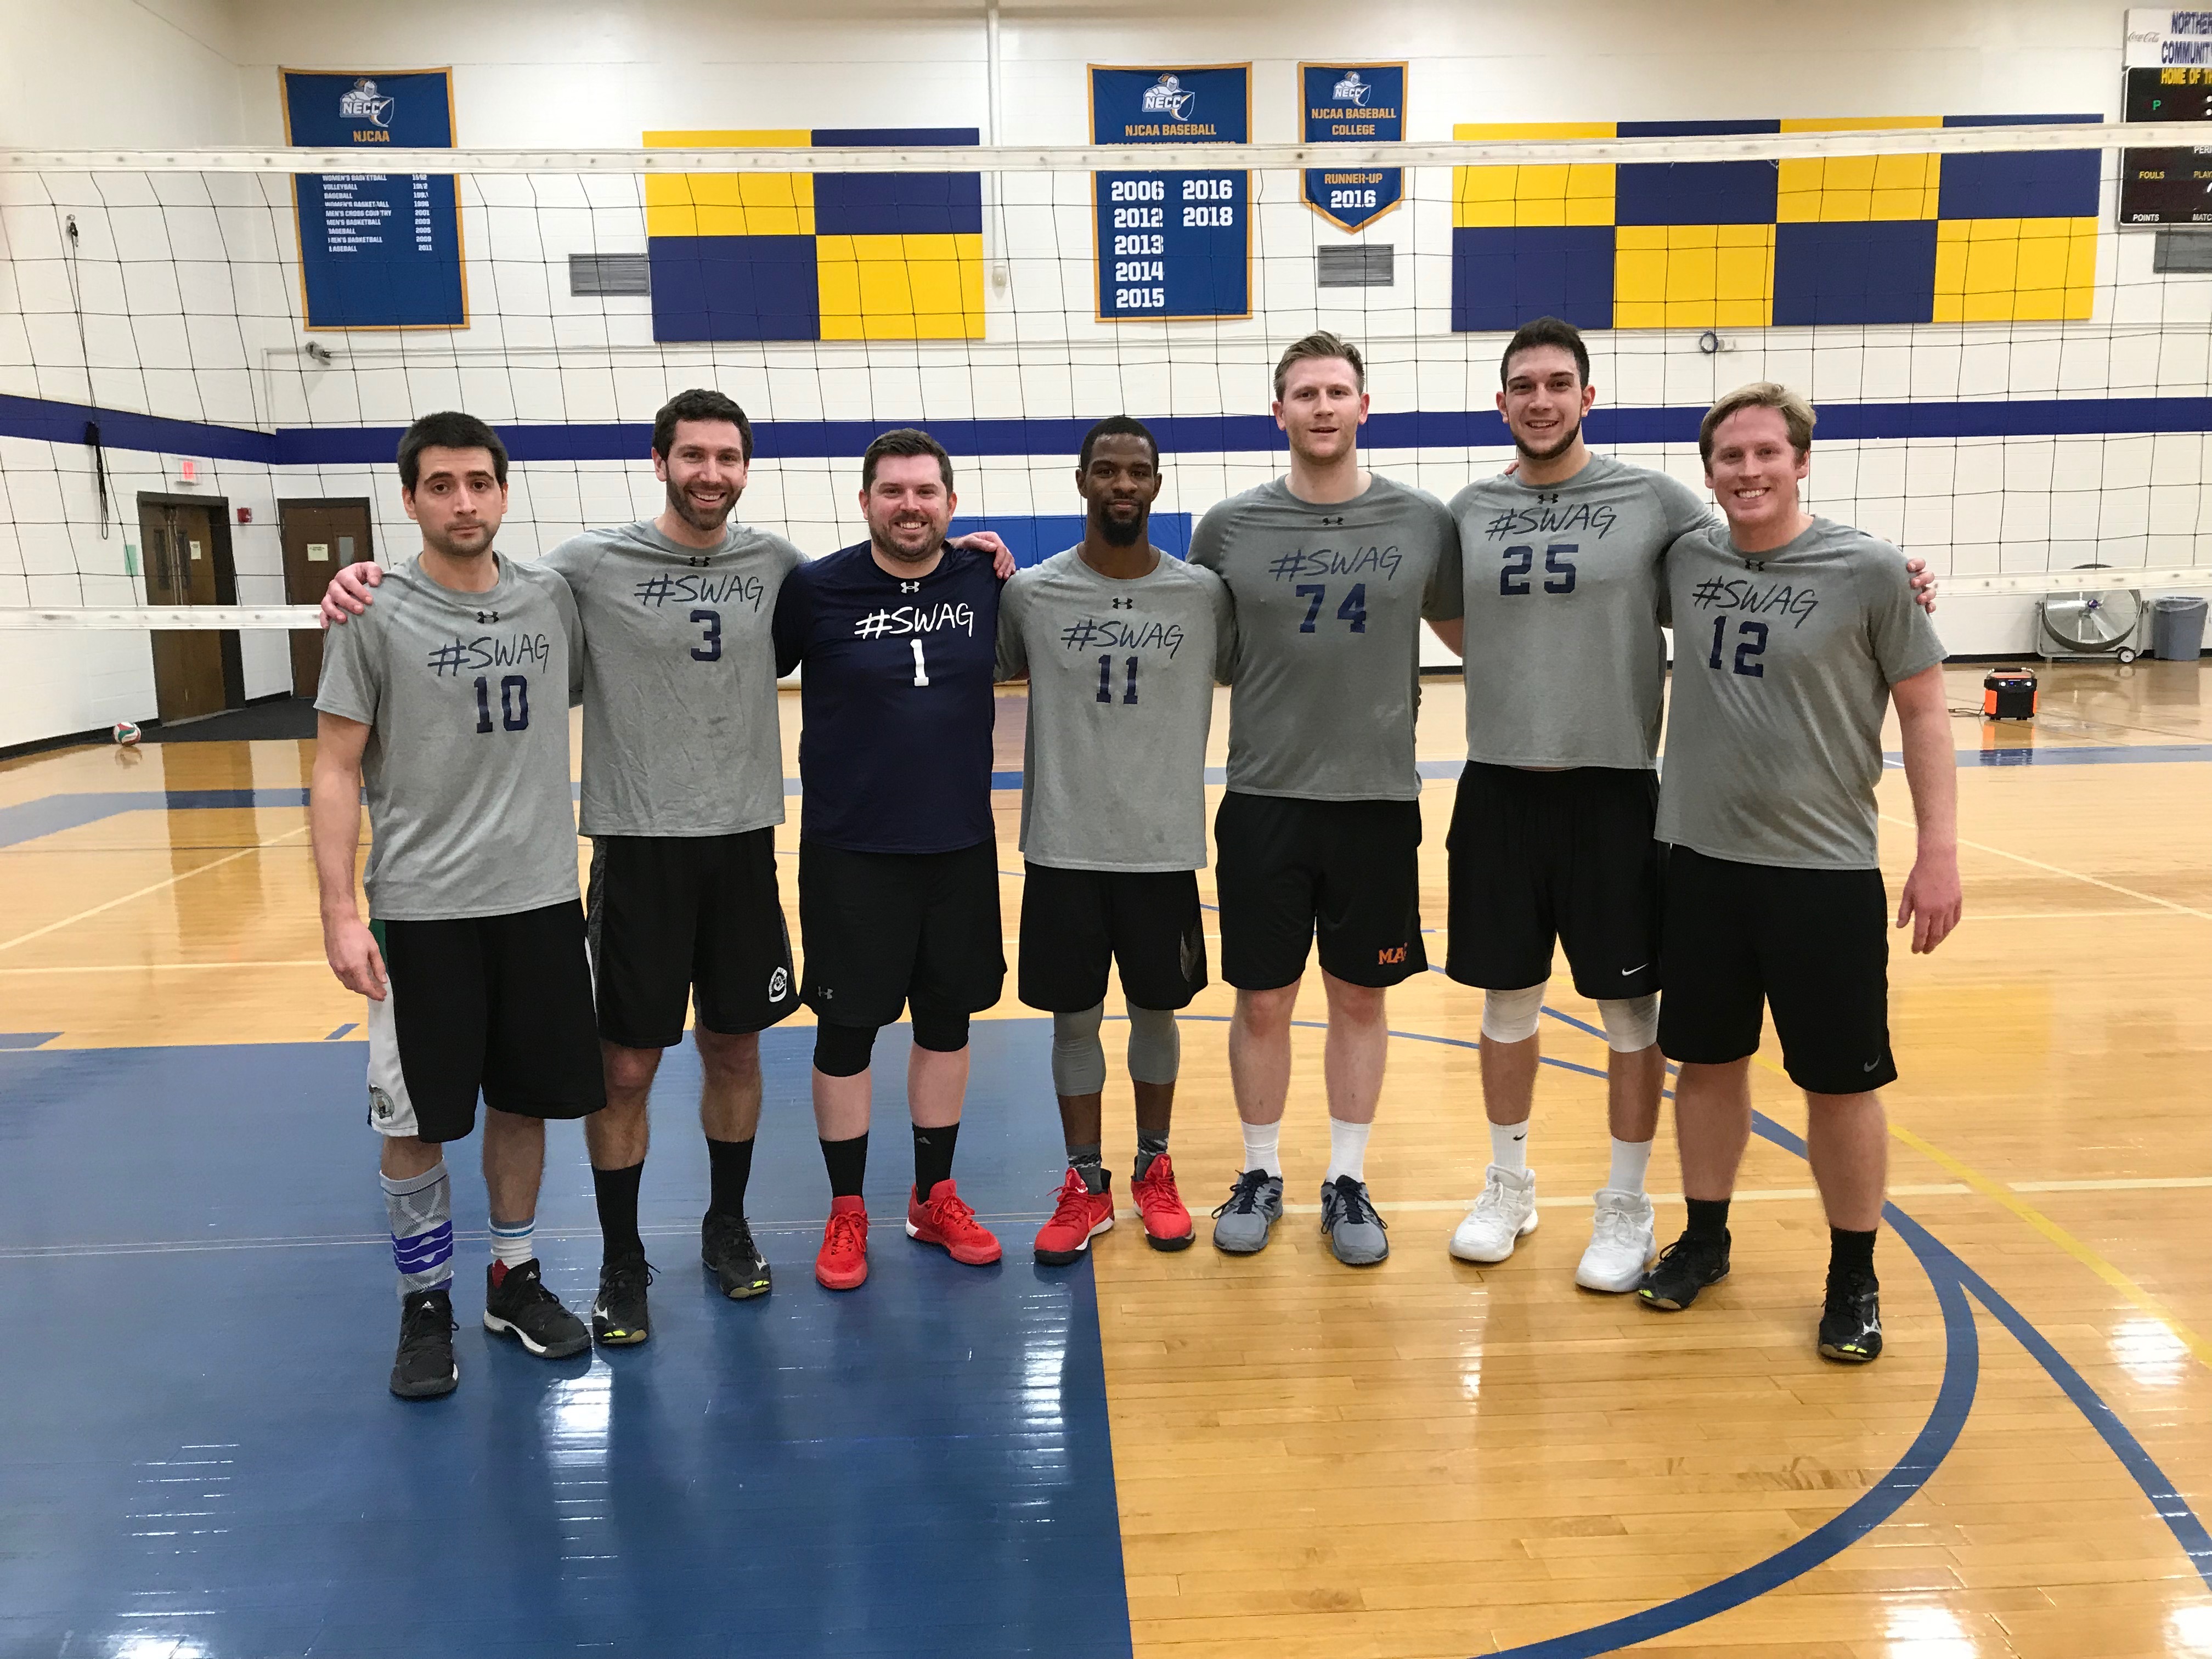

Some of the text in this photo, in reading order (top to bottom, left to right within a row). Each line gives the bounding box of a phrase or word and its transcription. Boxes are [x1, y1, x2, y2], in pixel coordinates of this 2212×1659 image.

[2162, 40, 2212, 64] COMMUNIT
[2161, 67, 2186, 84] HOME
[2190, 67, 2201, 84] OF
[1146, 96, 1181, 109] NECC
[1335, 88, 1361, 97] NECC
[343, 102, 380, 114] NECC
[1312, 108, 1396, 119] NJCAA BASEBALL
[353, 130, 390, 142] NJCAA
[1125, 123, 1217, 136] NJCAA BASEBALL
[1332, 124, 1375, 135] COLLEGE
[1324, 173, 1383, 184] RUNNER-UP
[2139, 171, 2165, 179] FOULS
[1111, 179, 1233, 201] 2006 2016
[1330, 190, 1376, 208] 2016
[1114, 206, 1233, 228] 2012 2018
[2132, 213, 2159, 222] POINTS
[1114, 234, 1164, 255] 2013
[1115, 261, 1164, 281] 2014
[1116, 288, 1164, 308] 2015
[1485, 503, 1617, 541] #SWAG
[1268, 545, 1402, 582] #SWAG
[1500, 544, 1579, 595] 25
[634, 573, 764, 613] #SWAG
[1692, 575, 1819, 629] #SWAG
[1295, 583, 1367, 633] 74
[854, 603, 974, 640] #SWAG
[690, 610, 721, 662] 3
[1060, 619, 1184, 659] #SWAG
[1709, 615, 1769, 678] 12
[427, 634, 549, 676] #SWAG
[910, 639, 929, 686] 1
[1096, 654, 1138, 704] 11
[474, 675, 529, 733] 10
